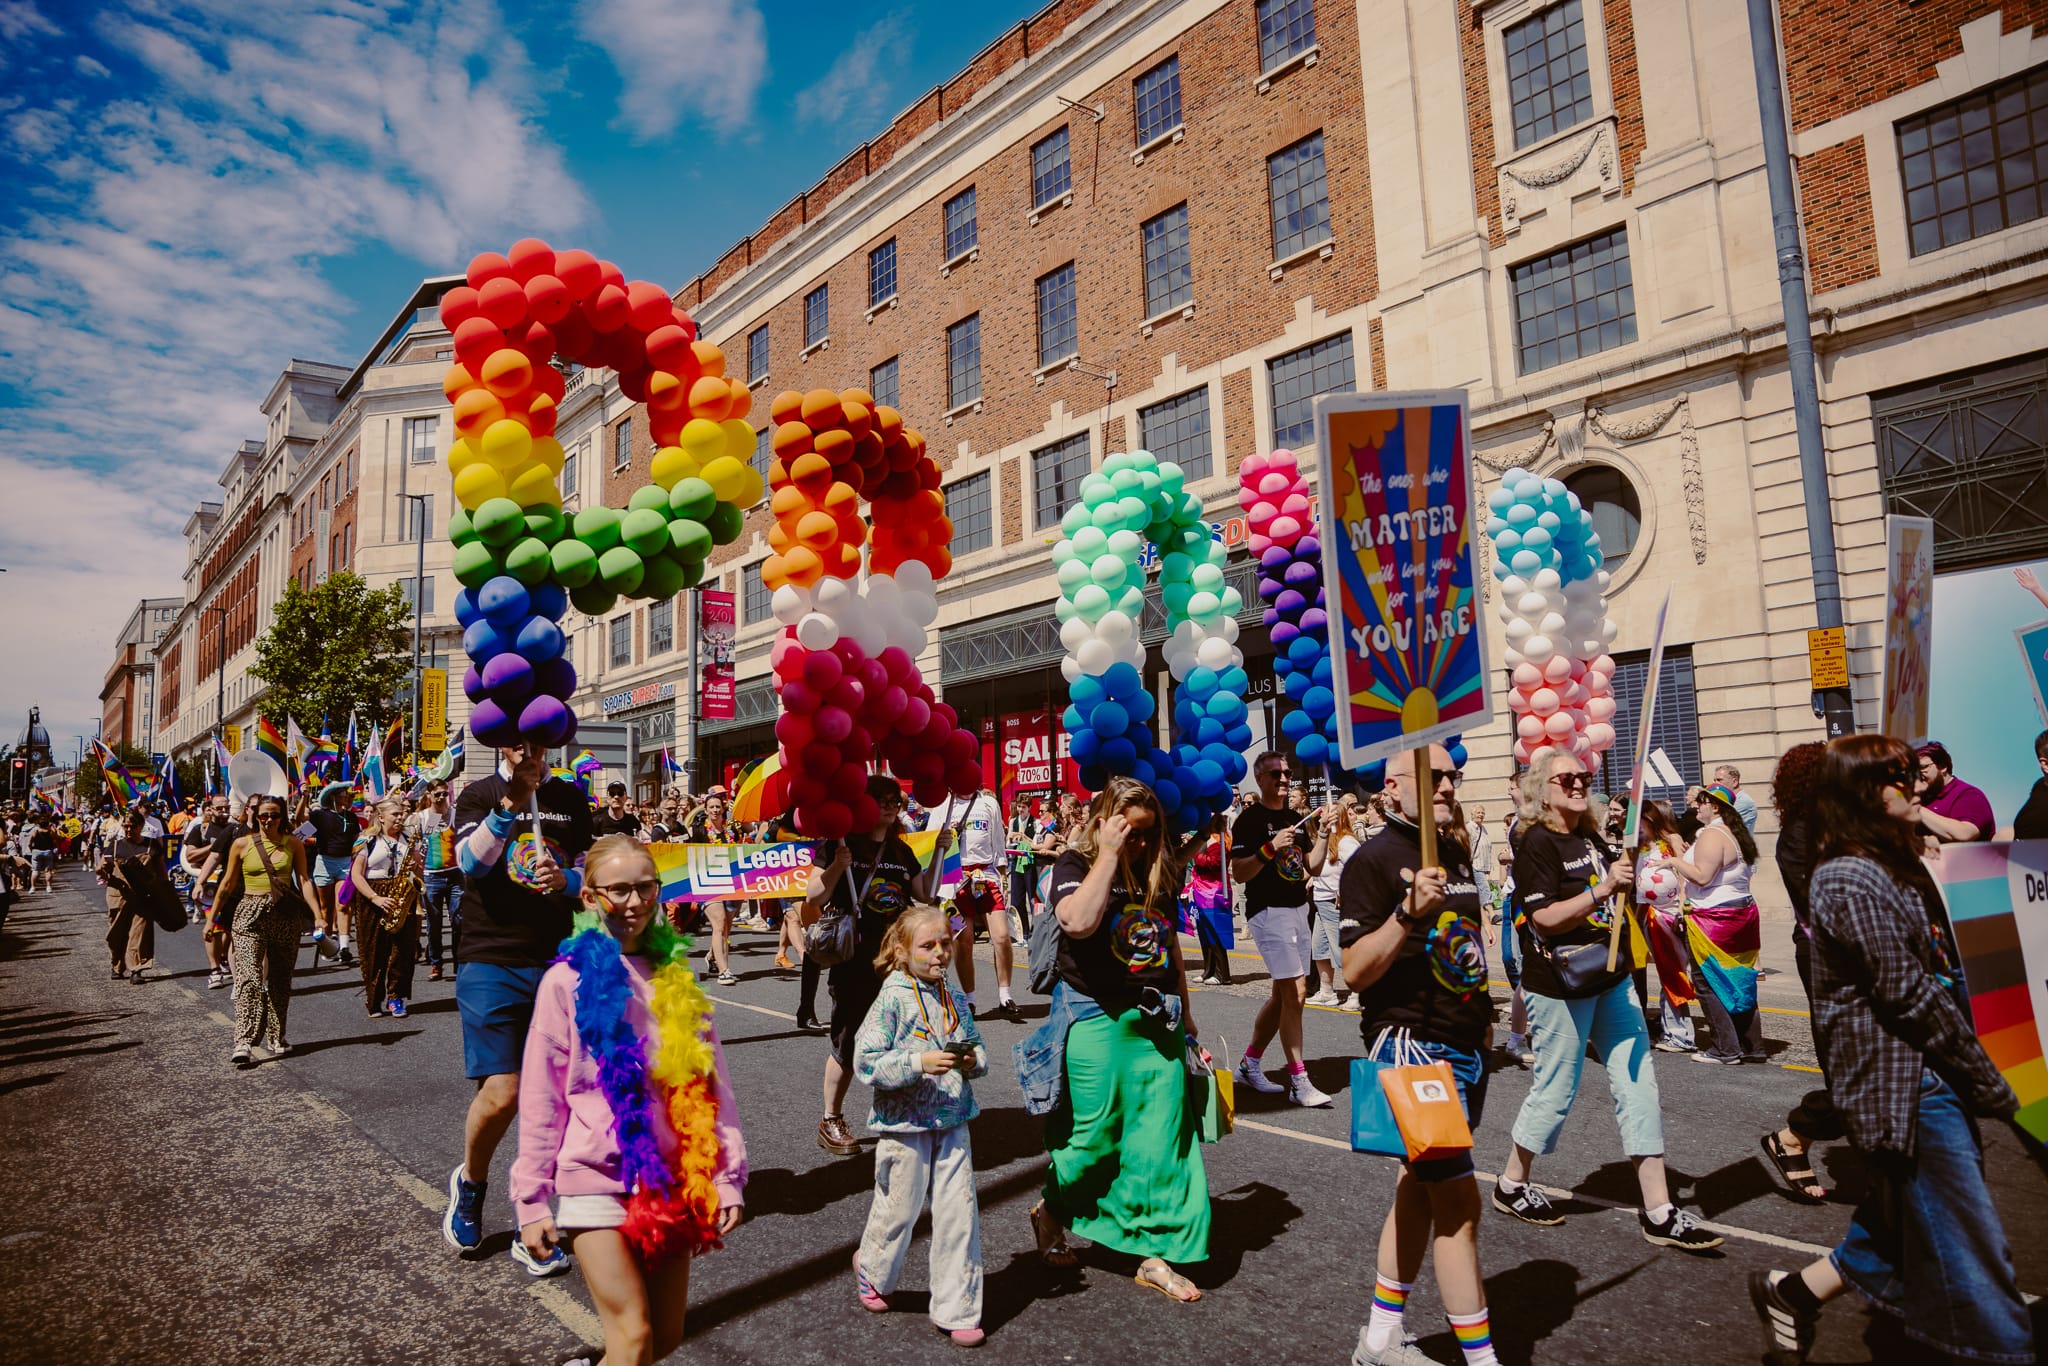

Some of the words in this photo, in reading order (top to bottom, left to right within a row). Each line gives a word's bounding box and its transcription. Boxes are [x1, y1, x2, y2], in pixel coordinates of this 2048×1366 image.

[1360, 472, 1382, 494] the
[1387, 473, 1415, 489] ones
[1422, 464, 1449, 486] who
[1350, 504, 1457, 552] MATTER
[1367, 563, 1394, 584] will
[1401, 562, 1425, 578] love
[1431, 558, 1452, 577] you
[1385, 591, 1408, 617] for
[1415, 581, 1440, 603] who
[1351, 617, 1412, 658] YOU
[1424, 606, 1471, 645] ARE
[1247, 678, 1272, 695] LUS
[1006, 718, 1019, 727] BOSS
[1832, 722, 1839, 730] 8
[1004, 733, 1073, 764] SALE
[1020, 767, 1041, 783] 70%
[1043, 764, 1061, 781] OF
[737, 844, 812, 869] Leeds
[740, 873, 789, 893] Law
